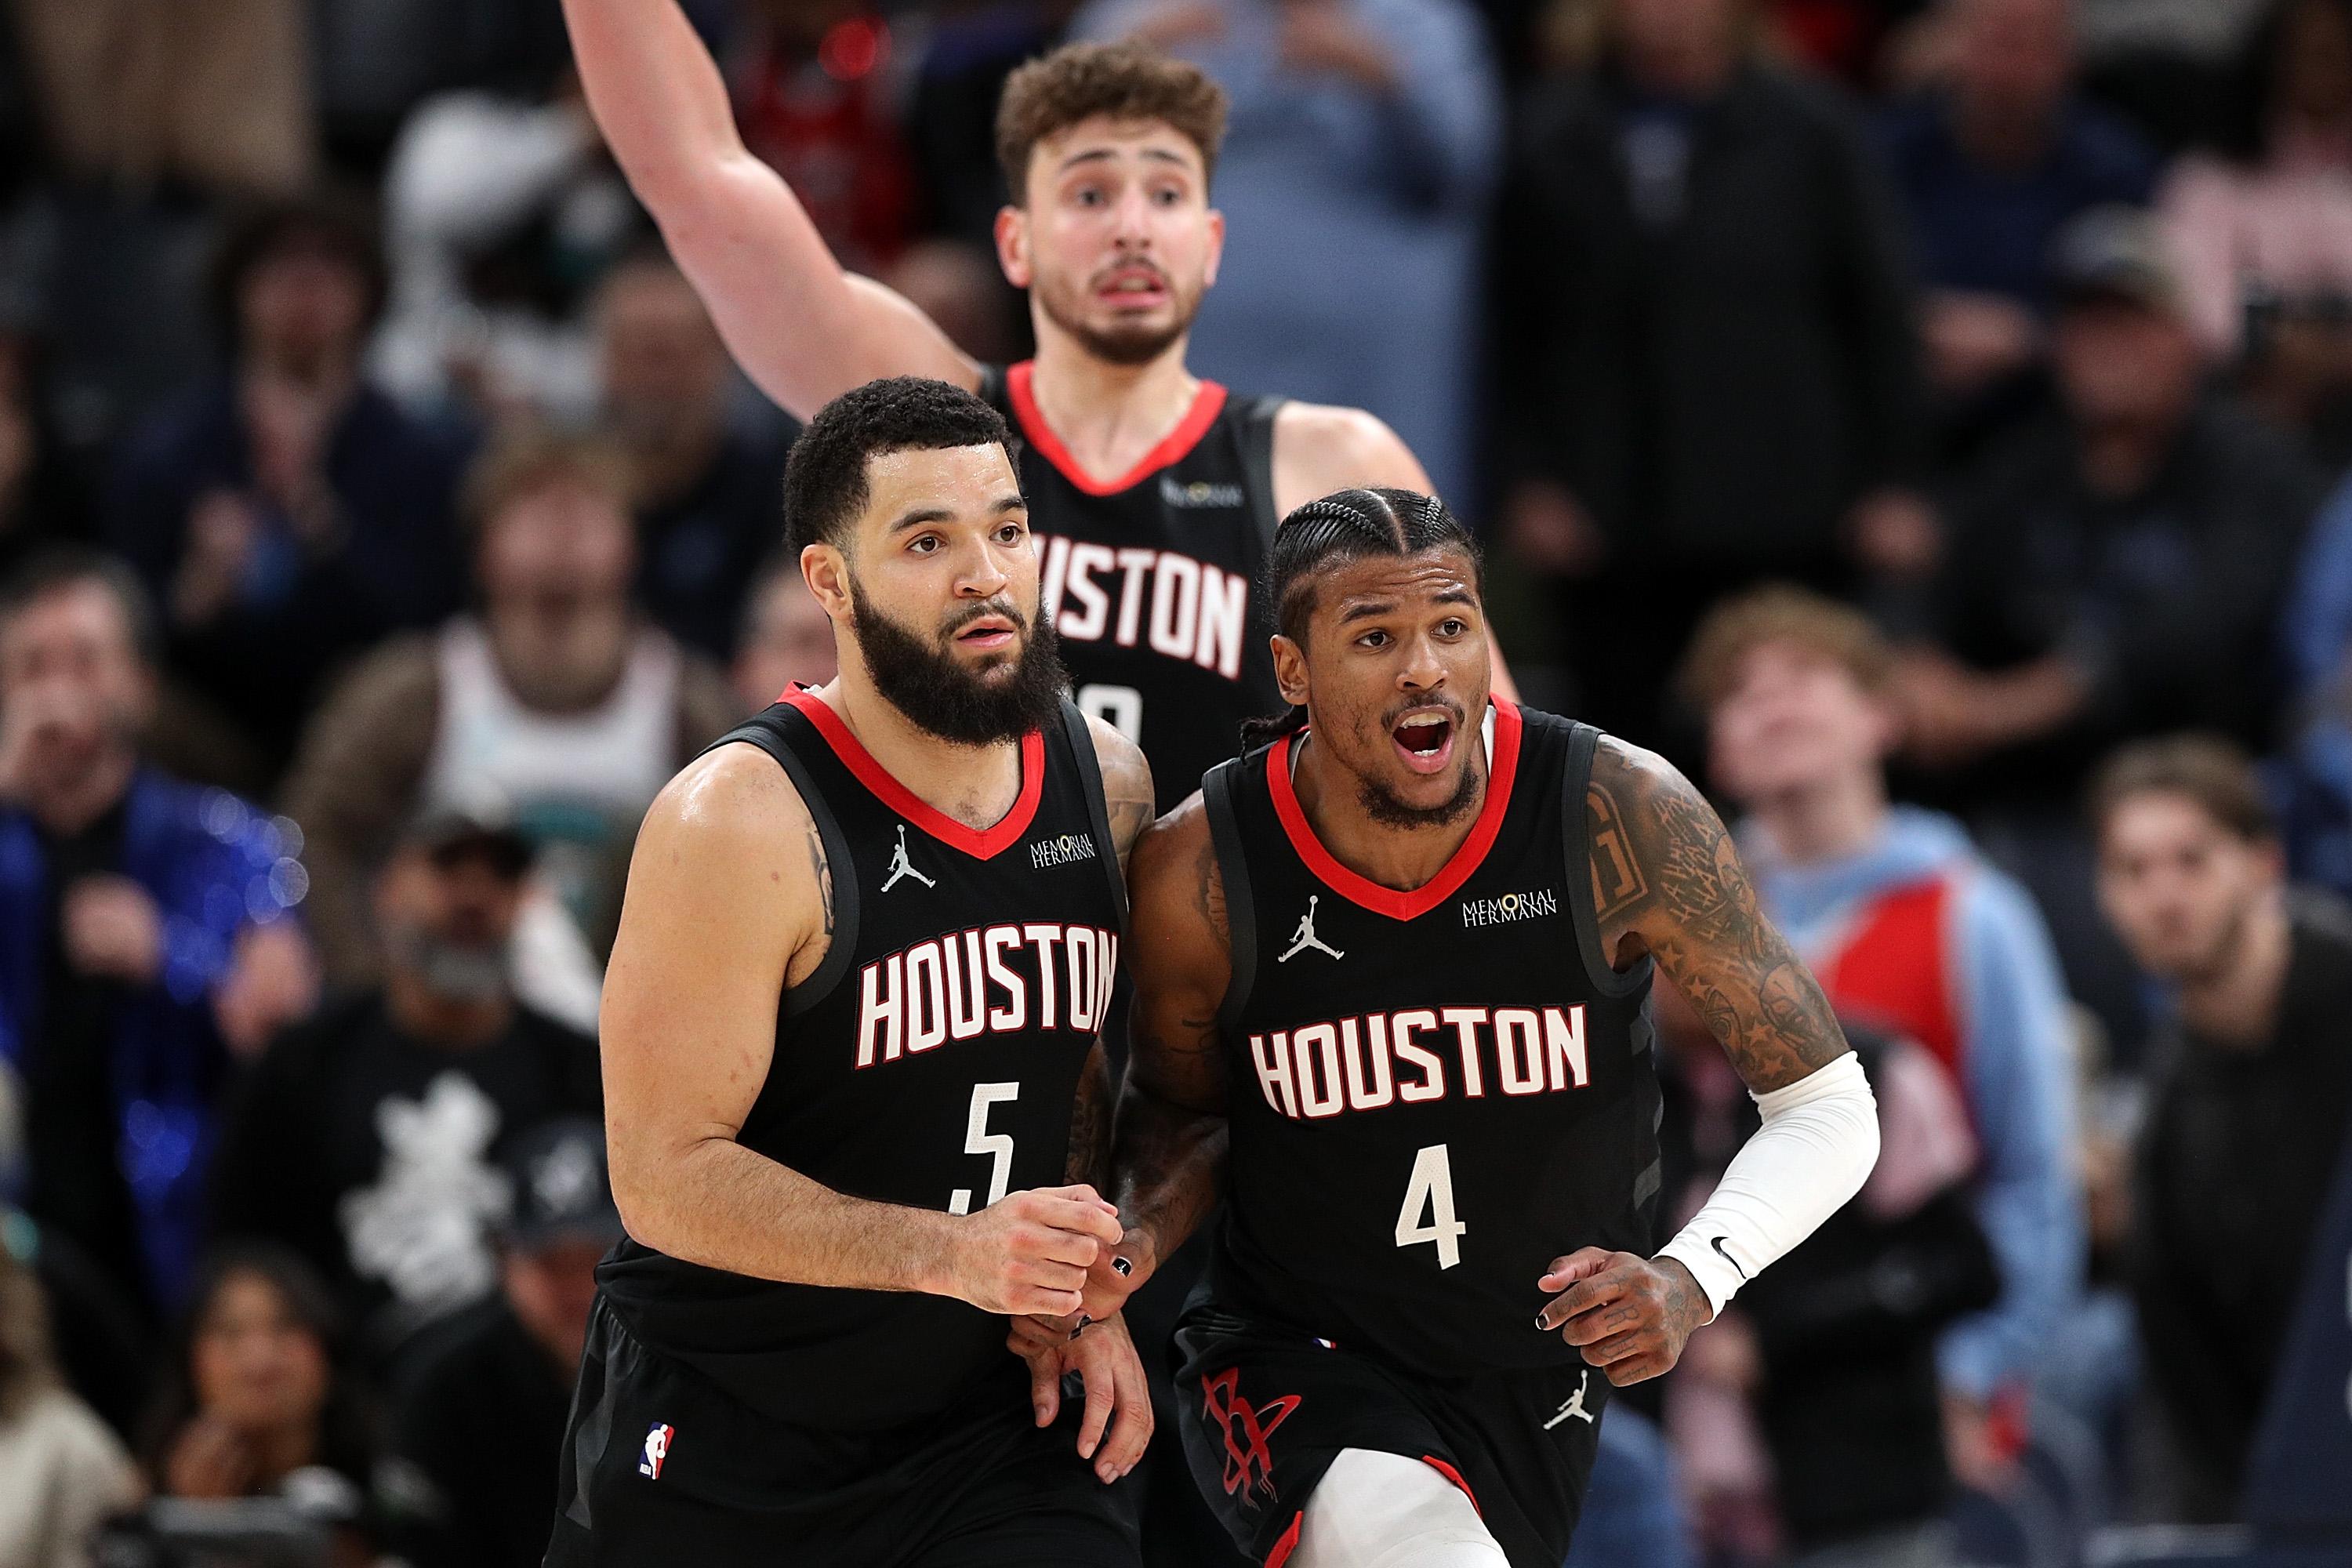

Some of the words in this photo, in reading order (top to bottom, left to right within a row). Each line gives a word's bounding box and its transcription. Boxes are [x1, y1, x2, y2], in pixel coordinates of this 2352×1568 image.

[1030, 531, 1248, 681] USTON
[1029, 833, 1093, 856] MEMORIAL
[1032, 845, 1096, 869] HERMANN
[1462, 888, 1556, 915] MEMORIAL
[1464, 901, 1557, 927] HERMANN
[855, 920, 1119, 1070] HOUSTON
[1248, 1002, 1591, 1120] HOUSTON
[949, 1082, 1019, 1216] 5
[1396, 1144, 1466, 1270] 4
